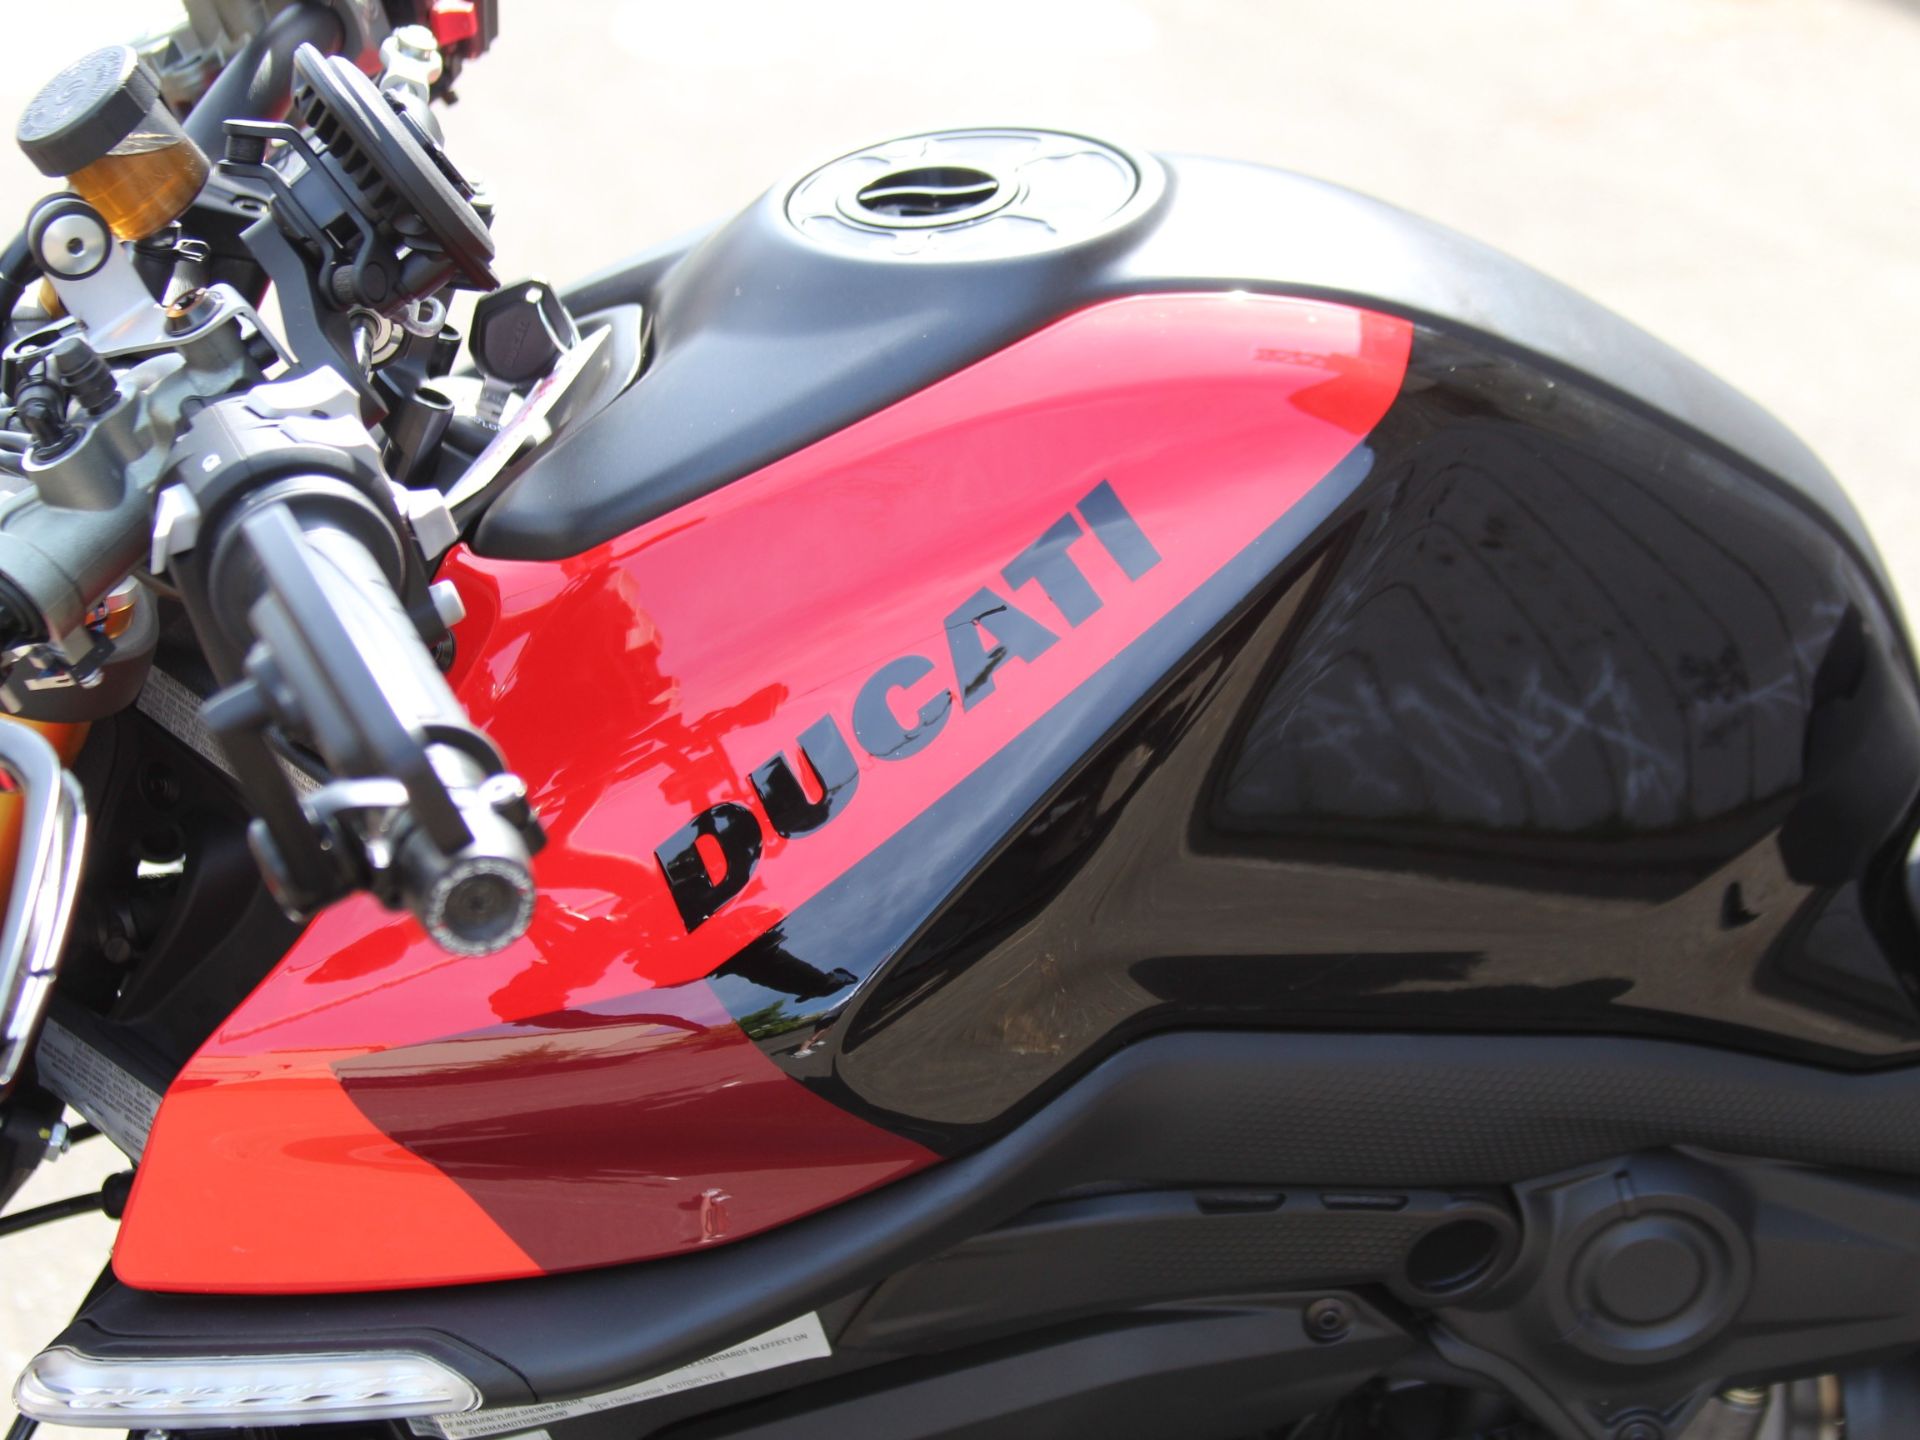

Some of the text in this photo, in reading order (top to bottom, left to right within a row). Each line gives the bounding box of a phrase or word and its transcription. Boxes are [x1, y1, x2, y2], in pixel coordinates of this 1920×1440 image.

[655, 479, 1162, 933] DUCATI
[760, 1337, 793, 1350] EFFECT
[793, 1332, 809, 1342] ON
